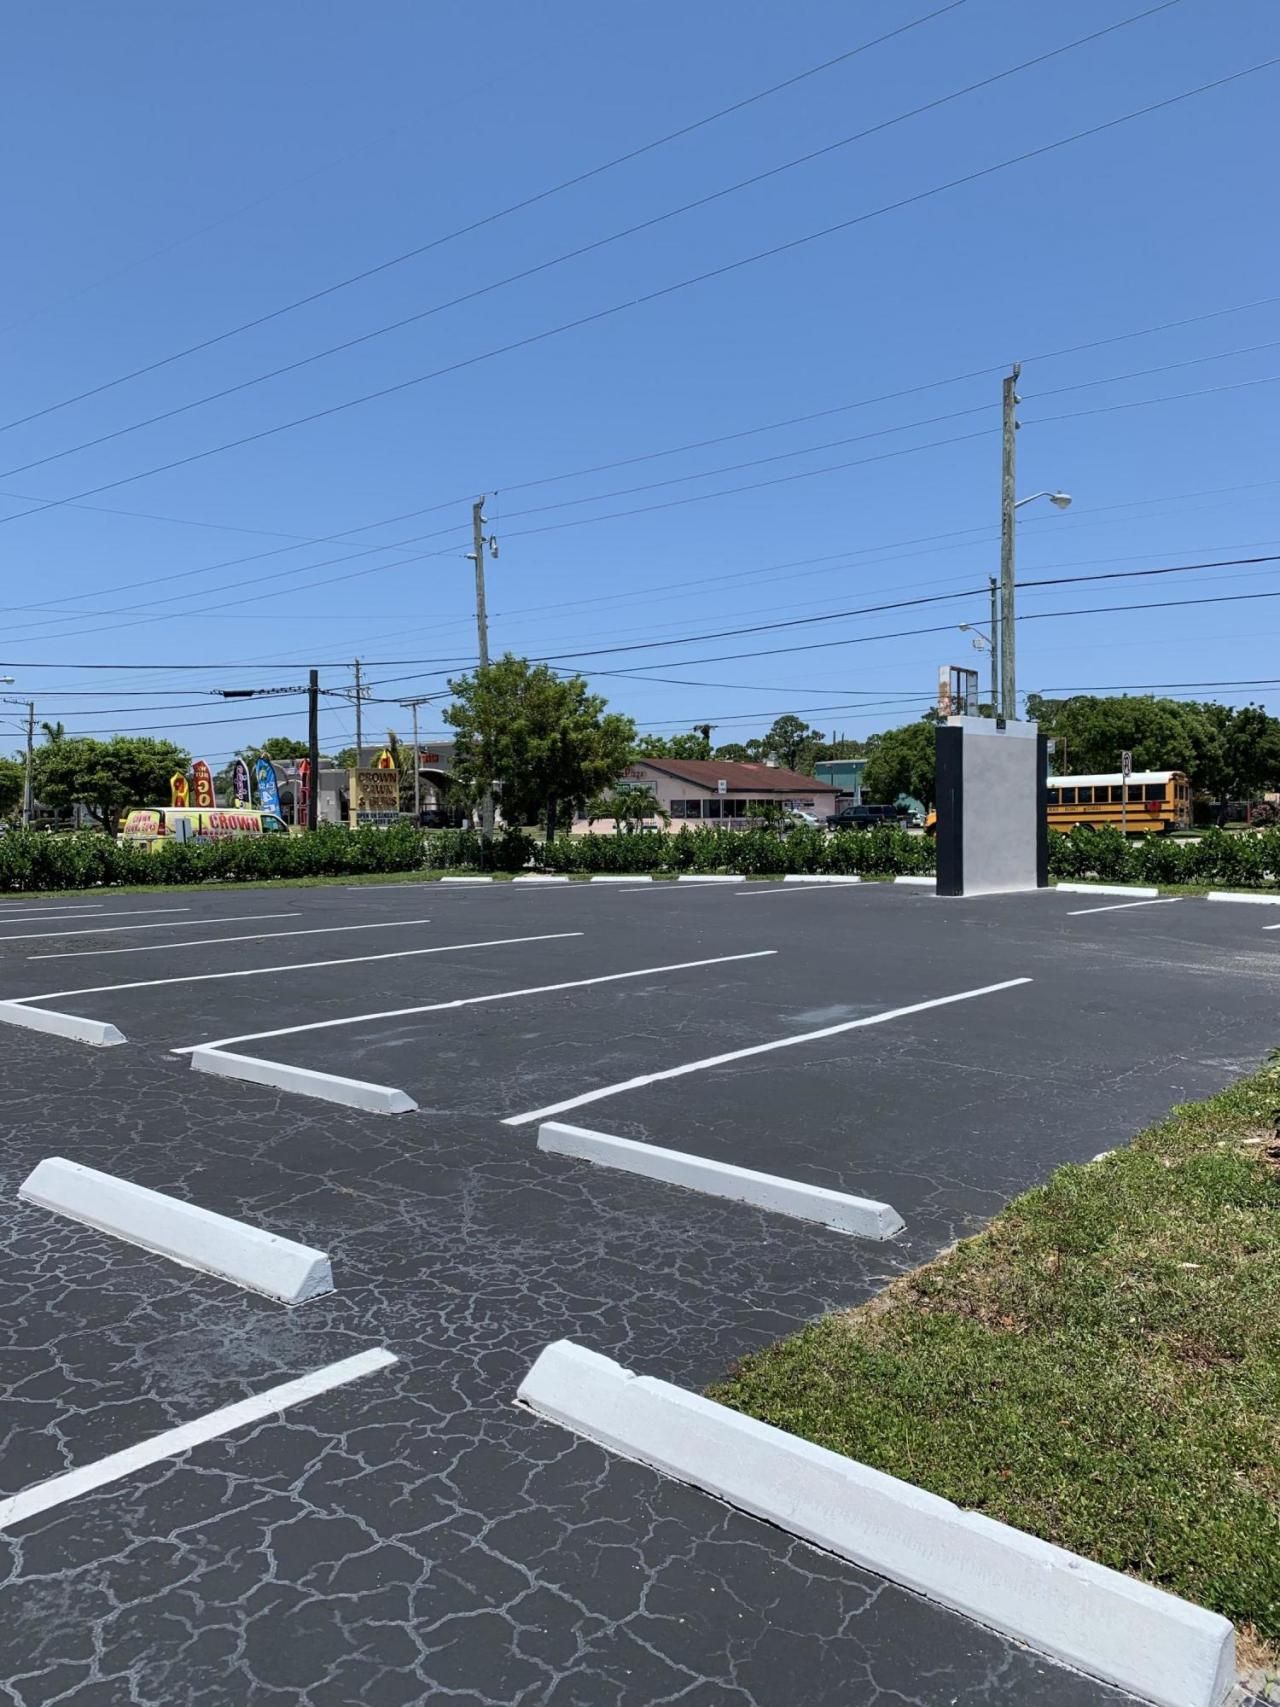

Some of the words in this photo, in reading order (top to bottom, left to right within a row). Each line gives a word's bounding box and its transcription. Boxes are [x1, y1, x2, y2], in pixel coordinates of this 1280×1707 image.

[358, 772, 397, 783] CROWN
[363, 784, 393, 795] PAWN
[209, 813, 260, 831] CROWN
